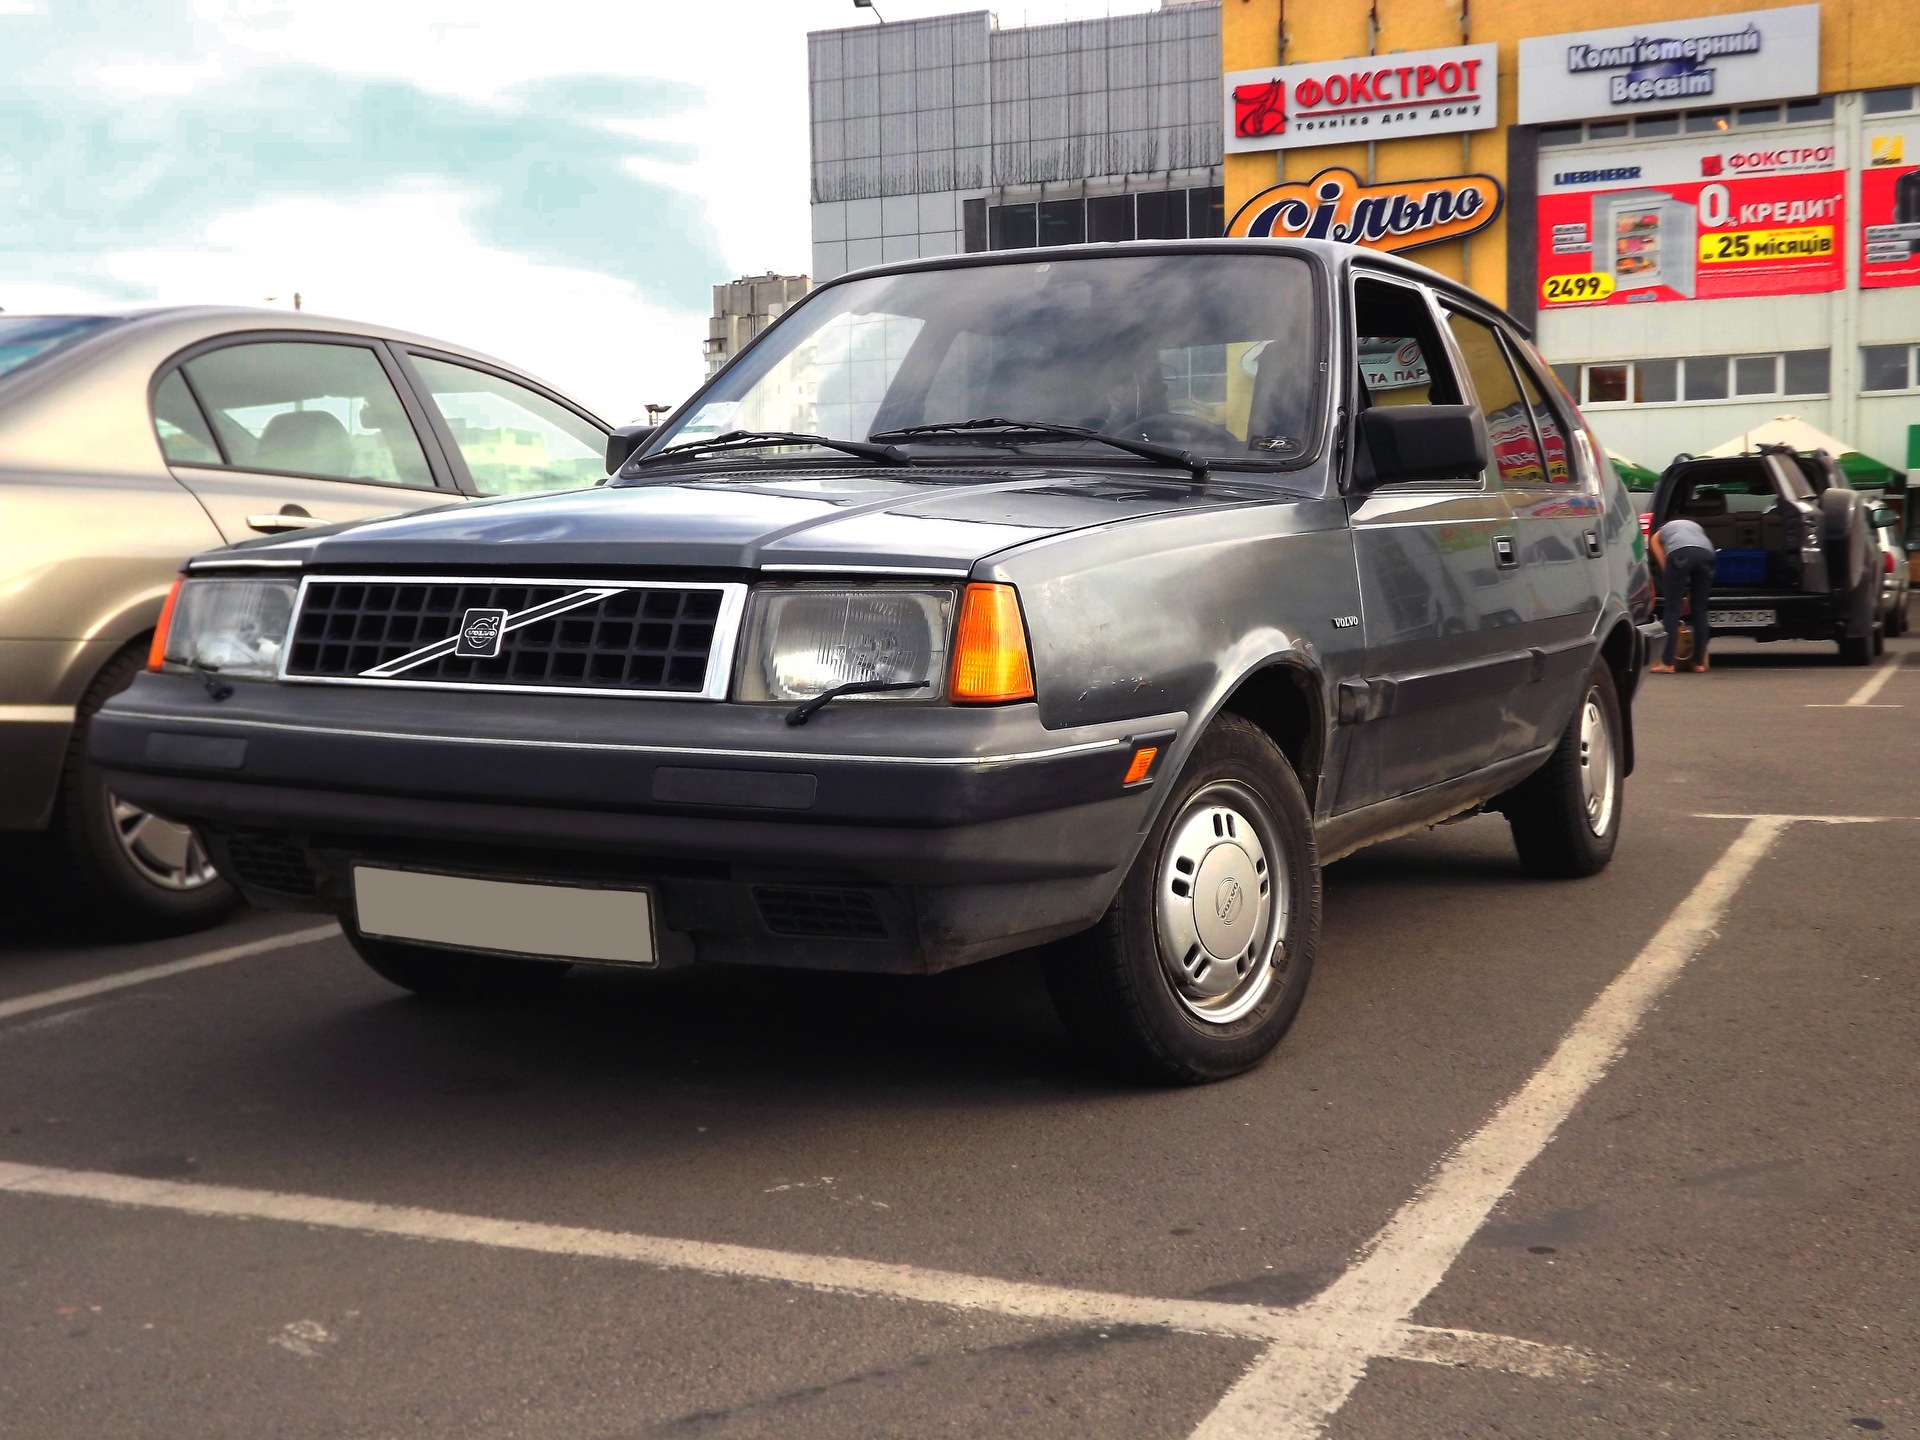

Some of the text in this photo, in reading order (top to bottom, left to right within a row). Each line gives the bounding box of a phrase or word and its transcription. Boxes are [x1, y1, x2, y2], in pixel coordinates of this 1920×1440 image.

[1295, 59, 1482, 107] ФОКСТРОТ
[1610, 68, 1715, 105] Всесвіт
[1296, 104, 1482, 131] техніка для дому
[1554, 166, 1642, 186] LIEBHERR
[1718, 235, 1750, 258] 25
[1754, 234, 1832, 257] місяців
[1547, 277, 1601, 298] 2499
[1368, 372, 1388, 384] ТА
[1333, 616, 1359, 628] VOLVO
[1220, 882, 1239, 919] VOLVO
